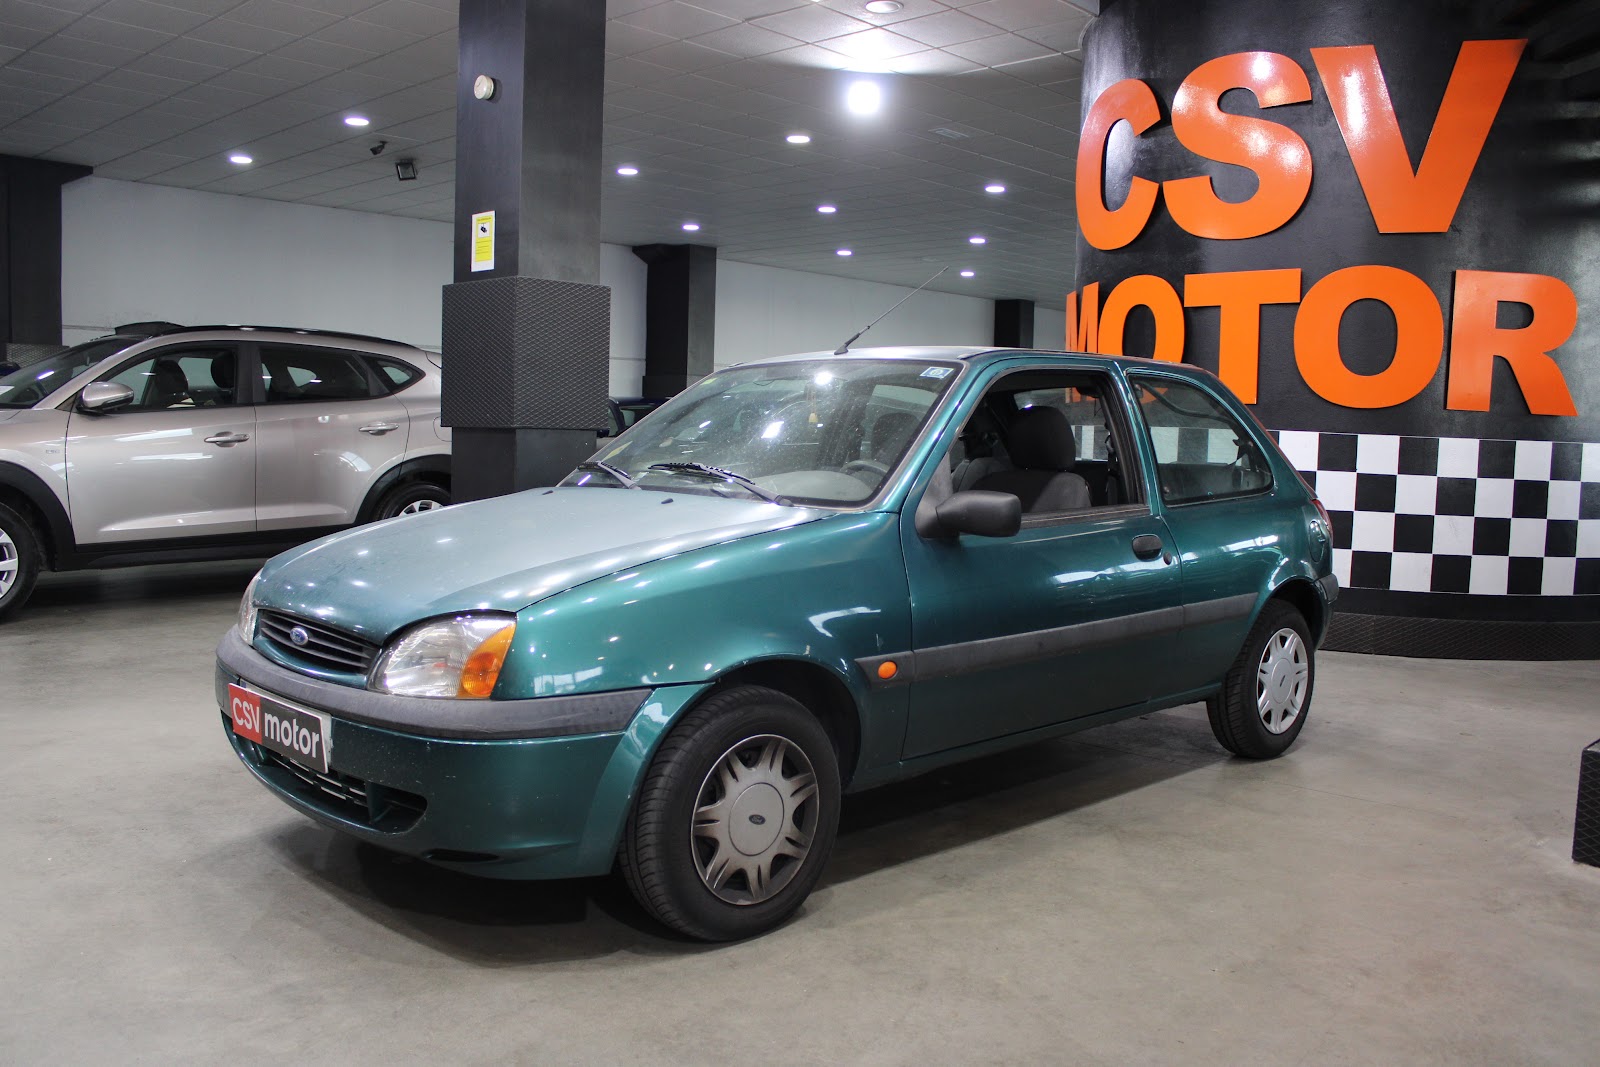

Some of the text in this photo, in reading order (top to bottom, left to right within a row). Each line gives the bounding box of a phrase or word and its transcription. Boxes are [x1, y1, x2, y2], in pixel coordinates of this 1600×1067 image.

[1076, 39, 1528, 250] CSV
[1065, 264, 1578, 416] MOTOR
[232, 697, 320, 758] CSV motor
